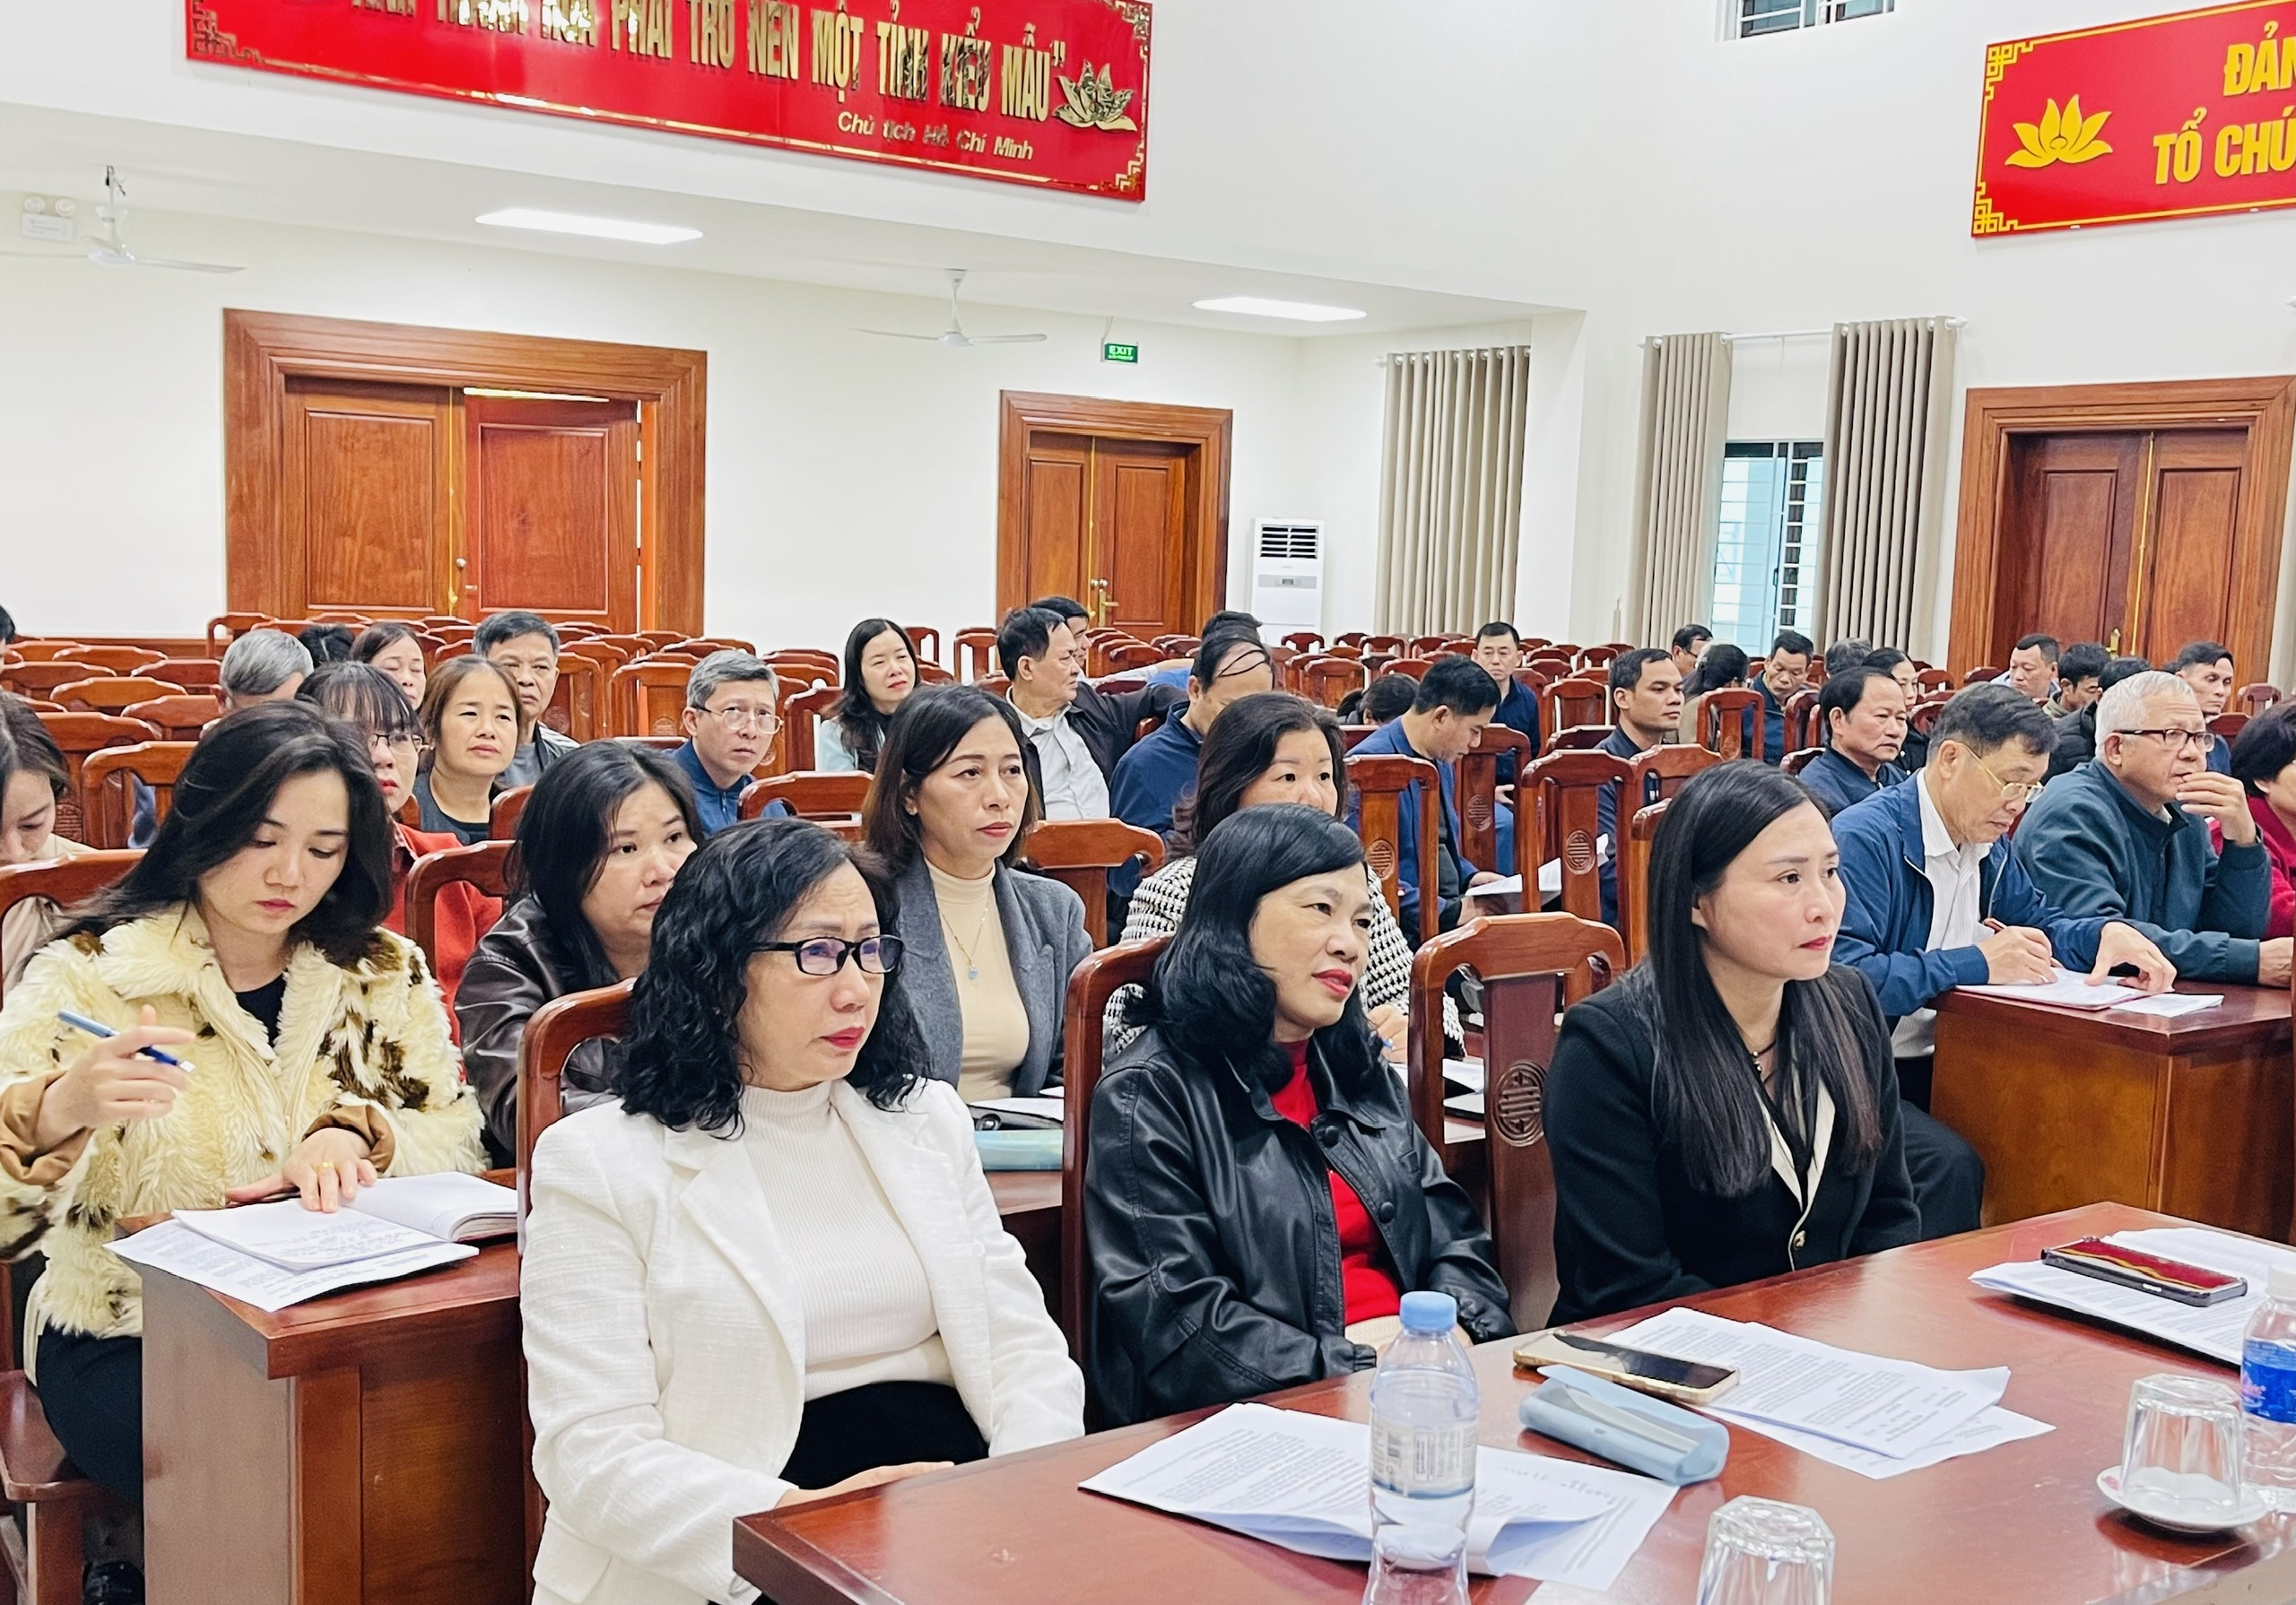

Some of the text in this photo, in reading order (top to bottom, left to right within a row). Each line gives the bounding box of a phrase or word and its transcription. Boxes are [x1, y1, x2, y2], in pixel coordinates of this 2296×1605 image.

[812, 0, 864, 103] MỘT
[876, 0, 929, 100] TỈNH
[941, 6, 991, 112] KIỂU
[838, 111, 874, 135] Chủ
[883, 120, 916, 143] tịch
[956, 129, 986, 154] Chí
[993, 136, 1033, 160] Minh
[2152, 107, 2207, 185] TỔ
[1109, 345, 1134, 356] EXIT
